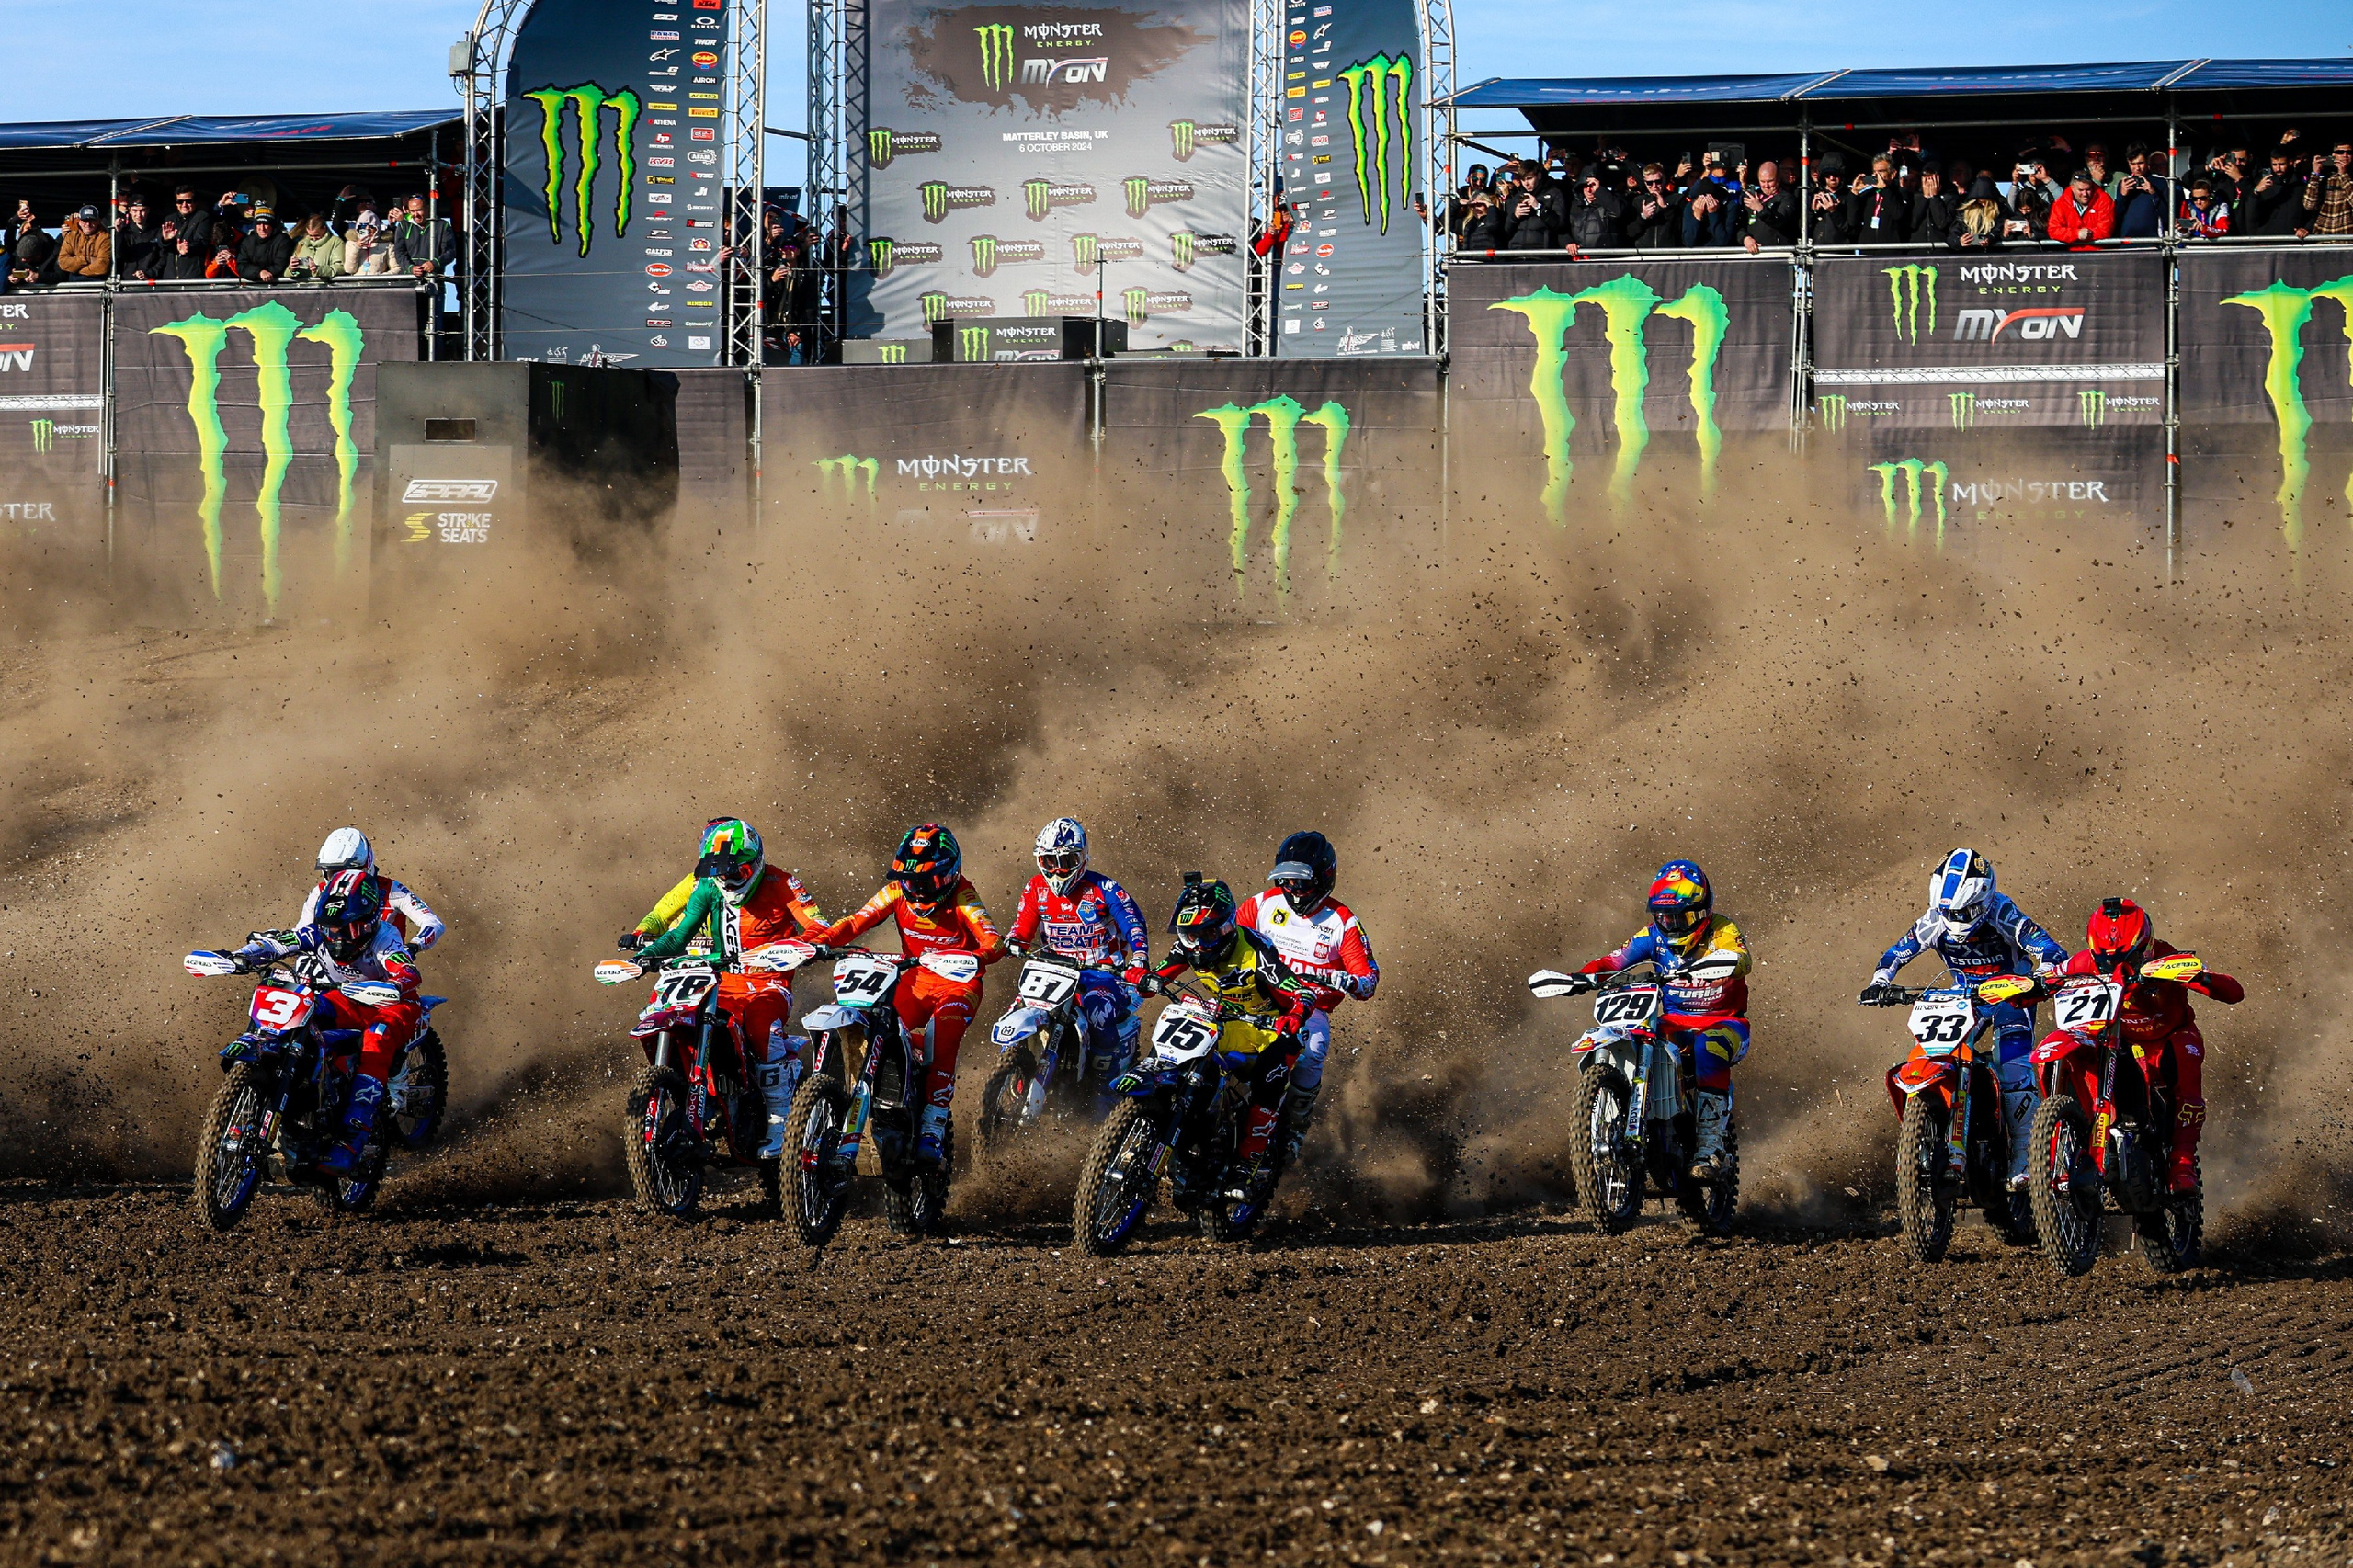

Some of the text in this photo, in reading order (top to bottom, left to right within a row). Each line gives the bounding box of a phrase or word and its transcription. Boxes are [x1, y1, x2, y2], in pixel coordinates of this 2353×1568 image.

[1024, 22, 1103, 39] MONSTER
[1003, 131, 1108, 142] MATTERLEY BASIN, UK
[1194, 127, 1236, 136] MONSTER
[892, 135, 938, 144] MONSTER
[1027, 143, 1070, 152] OCTOBER
[1072, 142, 1092, 151] 2024
[946, 189, 992, 199] MONSTER
[1048, 187, 1092, 196] MONSTER
[1147, 184, 1190, 193] MONSTER
[1097, 241, 1140, 250] MONSTER
[1193, 237, 1233, 246] MONSTER
[892, 245, 938, 256] MONSTER
[995, 244, 1040, 253] MONSTER
[1960, 263, 2078, 283] MONSTER
[946, 300, 991, 309] MONSTER
[1048, 298, 1091, 306] MONSTER
[1146, 295, 1188, 303] MONSTER
[996, 325, 1056, 337] MONSTER
[1847, 401, 1900, 411] MONSTER
[1976, 399, 2029, 408] MONSTER
[2106, 397, 2160, 405] MONSTER
[53, 425, 99, 435] MONSTER
[897, 454, 1032, 479] MONSTER
[919, 483, 1012, 492] ENERGY
[1952, 478, 2109, 506] MONSTER
[0, 502, 56, 522] TER
[1977, 510, 2086, 519] ENERGY
[437, 513, 492, 528] STRIKE
[440, 528, 488, 543] SEATS
[1049, 925, 1093, 936] TEAM
[1944, 943, 2001, 958] FXR
[1950, 954, 2004, 966] ESTONIA
[2165, 961, 2199, 970] ACERBIS
[837, 969, 888, 996] 54
[1020, 971, 1074, 1003] 87
[662, 976, 711, 1005] 78
[1668, 985, 1722, 999] FURIA
[1703, 994, 1722, 1002] TEAM
[256, 990, 301, 1025] 3
[1597, 994, 1654, 1025] 129
[2063, 994, 2109, 1024] 21
[1156, 1017, 1211, 1051] 15
[1915, 1015, 1967, 1042] 33
